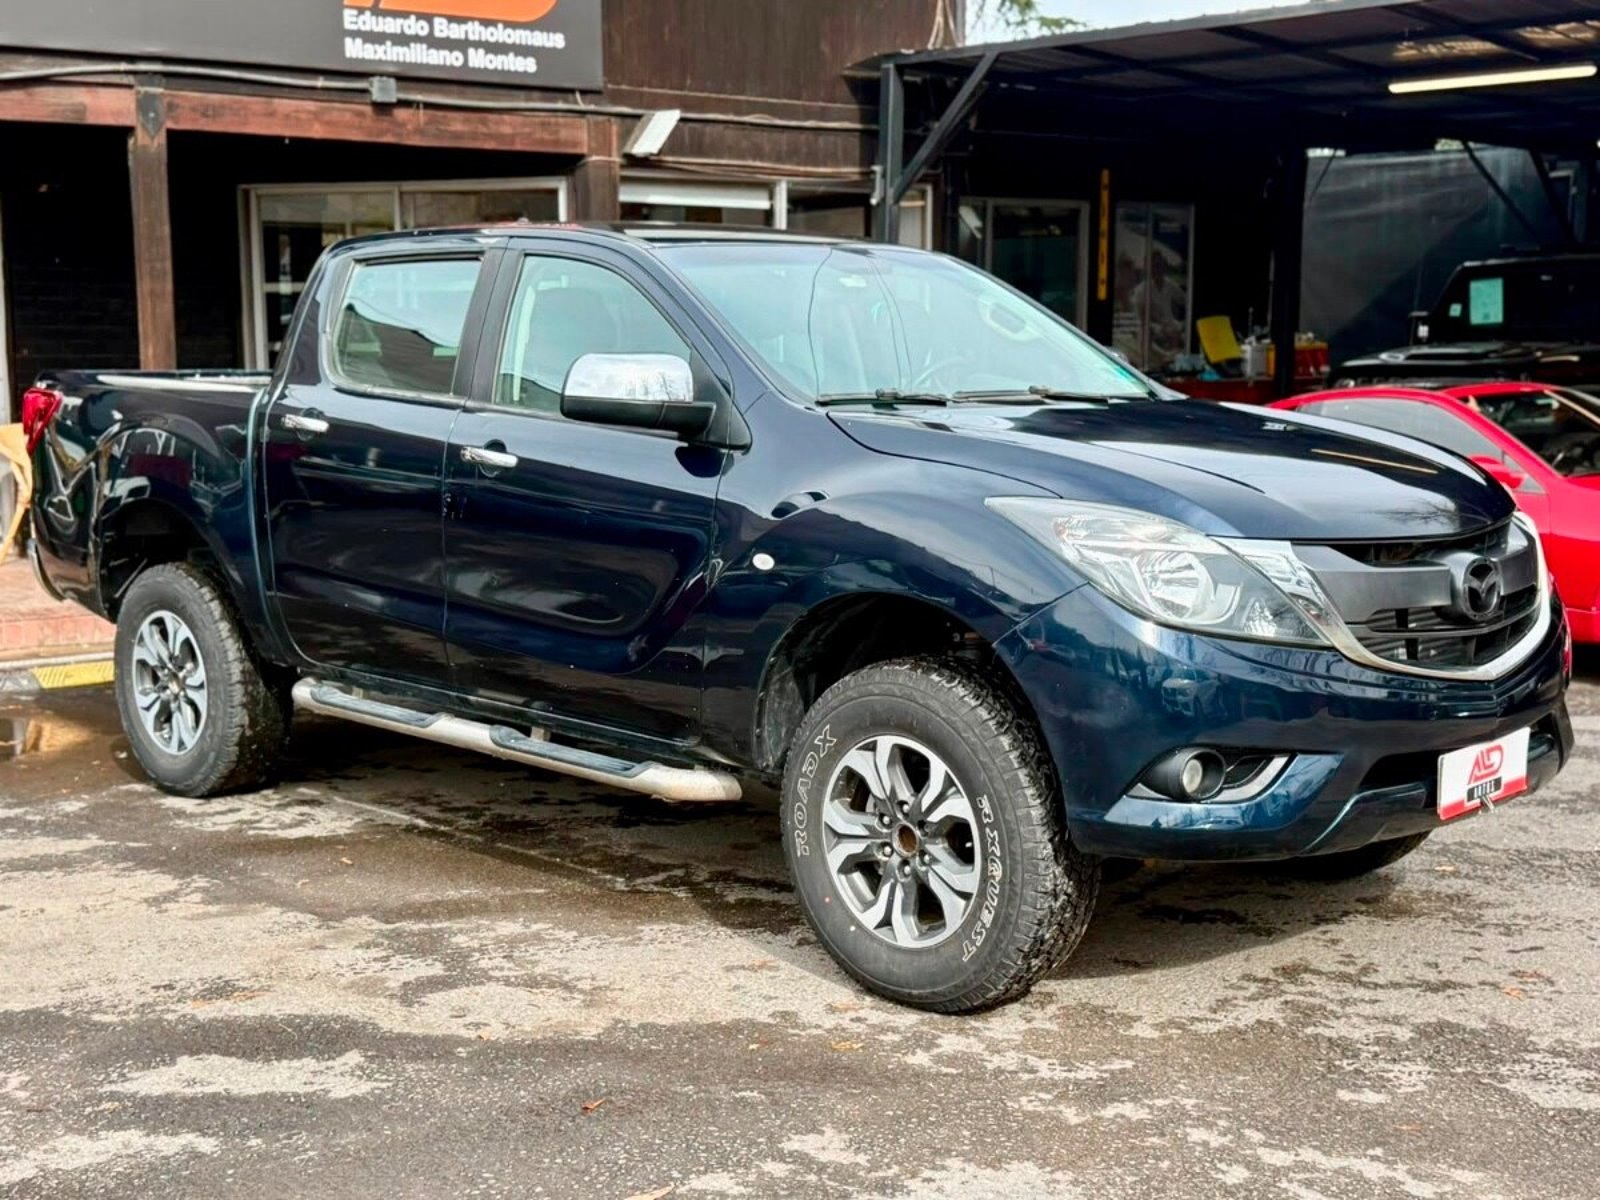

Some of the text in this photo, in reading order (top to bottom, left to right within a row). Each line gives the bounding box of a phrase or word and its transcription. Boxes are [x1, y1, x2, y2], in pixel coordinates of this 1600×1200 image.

[343, 9, 566, 49] Eduardo Bartholomaus
[344, 37, 537, 73] Maximiliano Montes
[794, 724, 837, 857] ROADX
